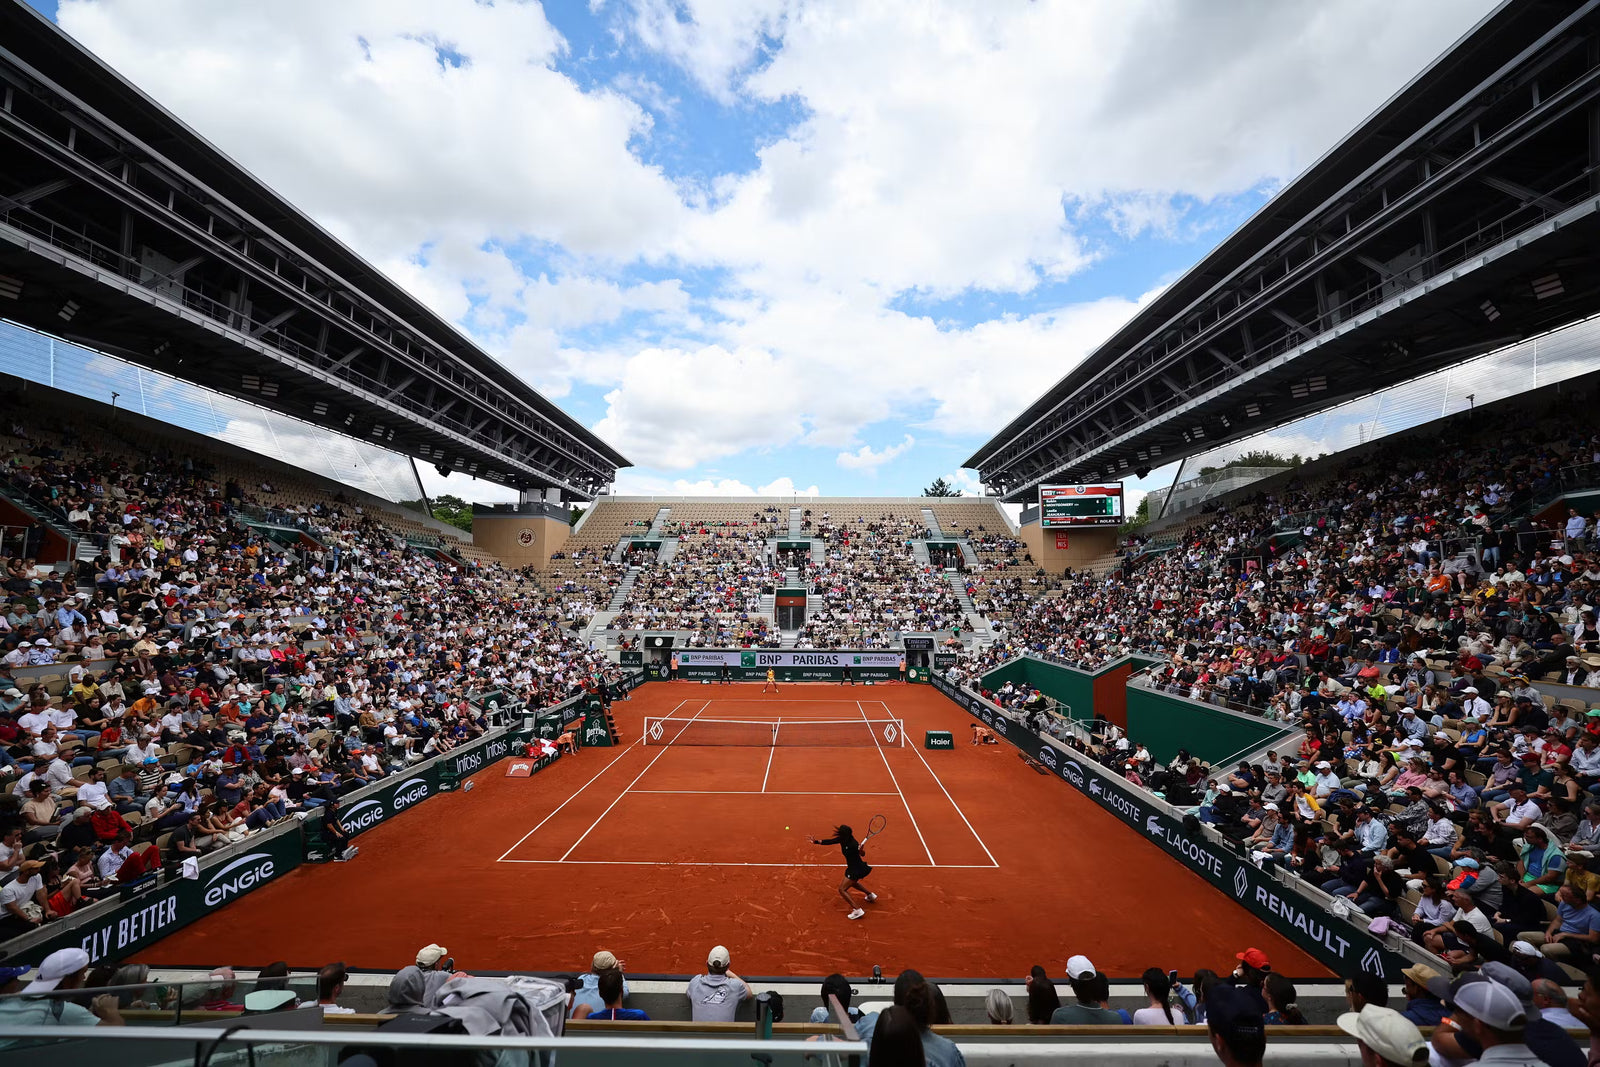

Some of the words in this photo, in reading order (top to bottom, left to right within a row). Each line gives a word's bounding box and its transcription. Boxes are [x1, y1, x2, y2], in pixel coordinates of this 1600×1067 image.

[760, 655, 782, 664] BNP
[792, 655, 839, 665] PARIBAS
[1102, 787, 1141, 822] LACOSTE
[1166, 828, 1223, 878] LACOSTE
[118, 895, 177, 950] BETTER
[1256, 885, 1351, 958] RENAULT
